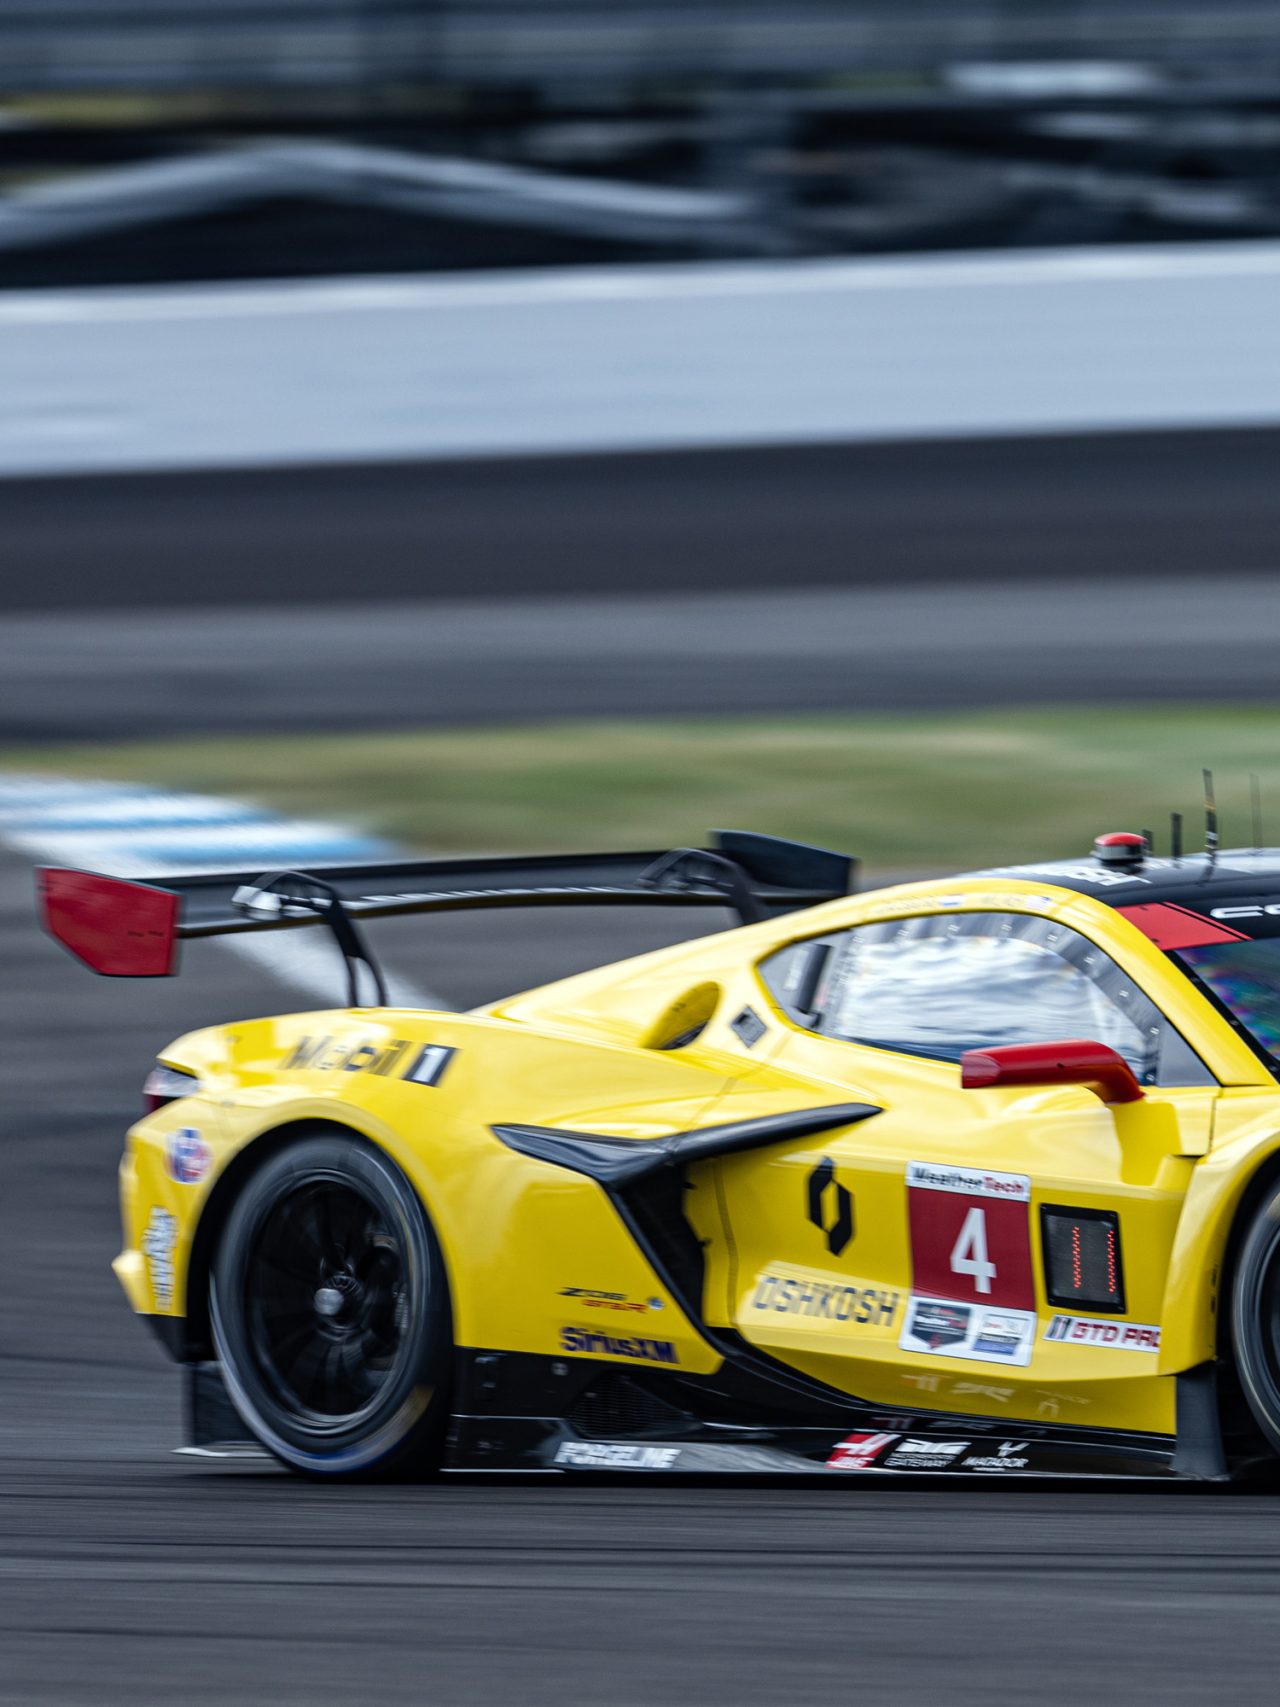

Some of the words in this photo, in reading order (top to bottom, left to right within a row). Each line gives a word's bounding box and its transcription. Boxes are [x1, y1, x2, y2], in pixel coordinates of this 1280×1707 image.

[279, 1035, 413, 1077] Mobil
[911, 1166, 1025, 1194] WeatherTech
[949, 1206, 997, 1294] 4
[752, 1276, 899, 1327] OSHKOSH
[559, 1326, 681, 1364] SiriusXM
[1071, 1321, 1120, 1342] GTD
